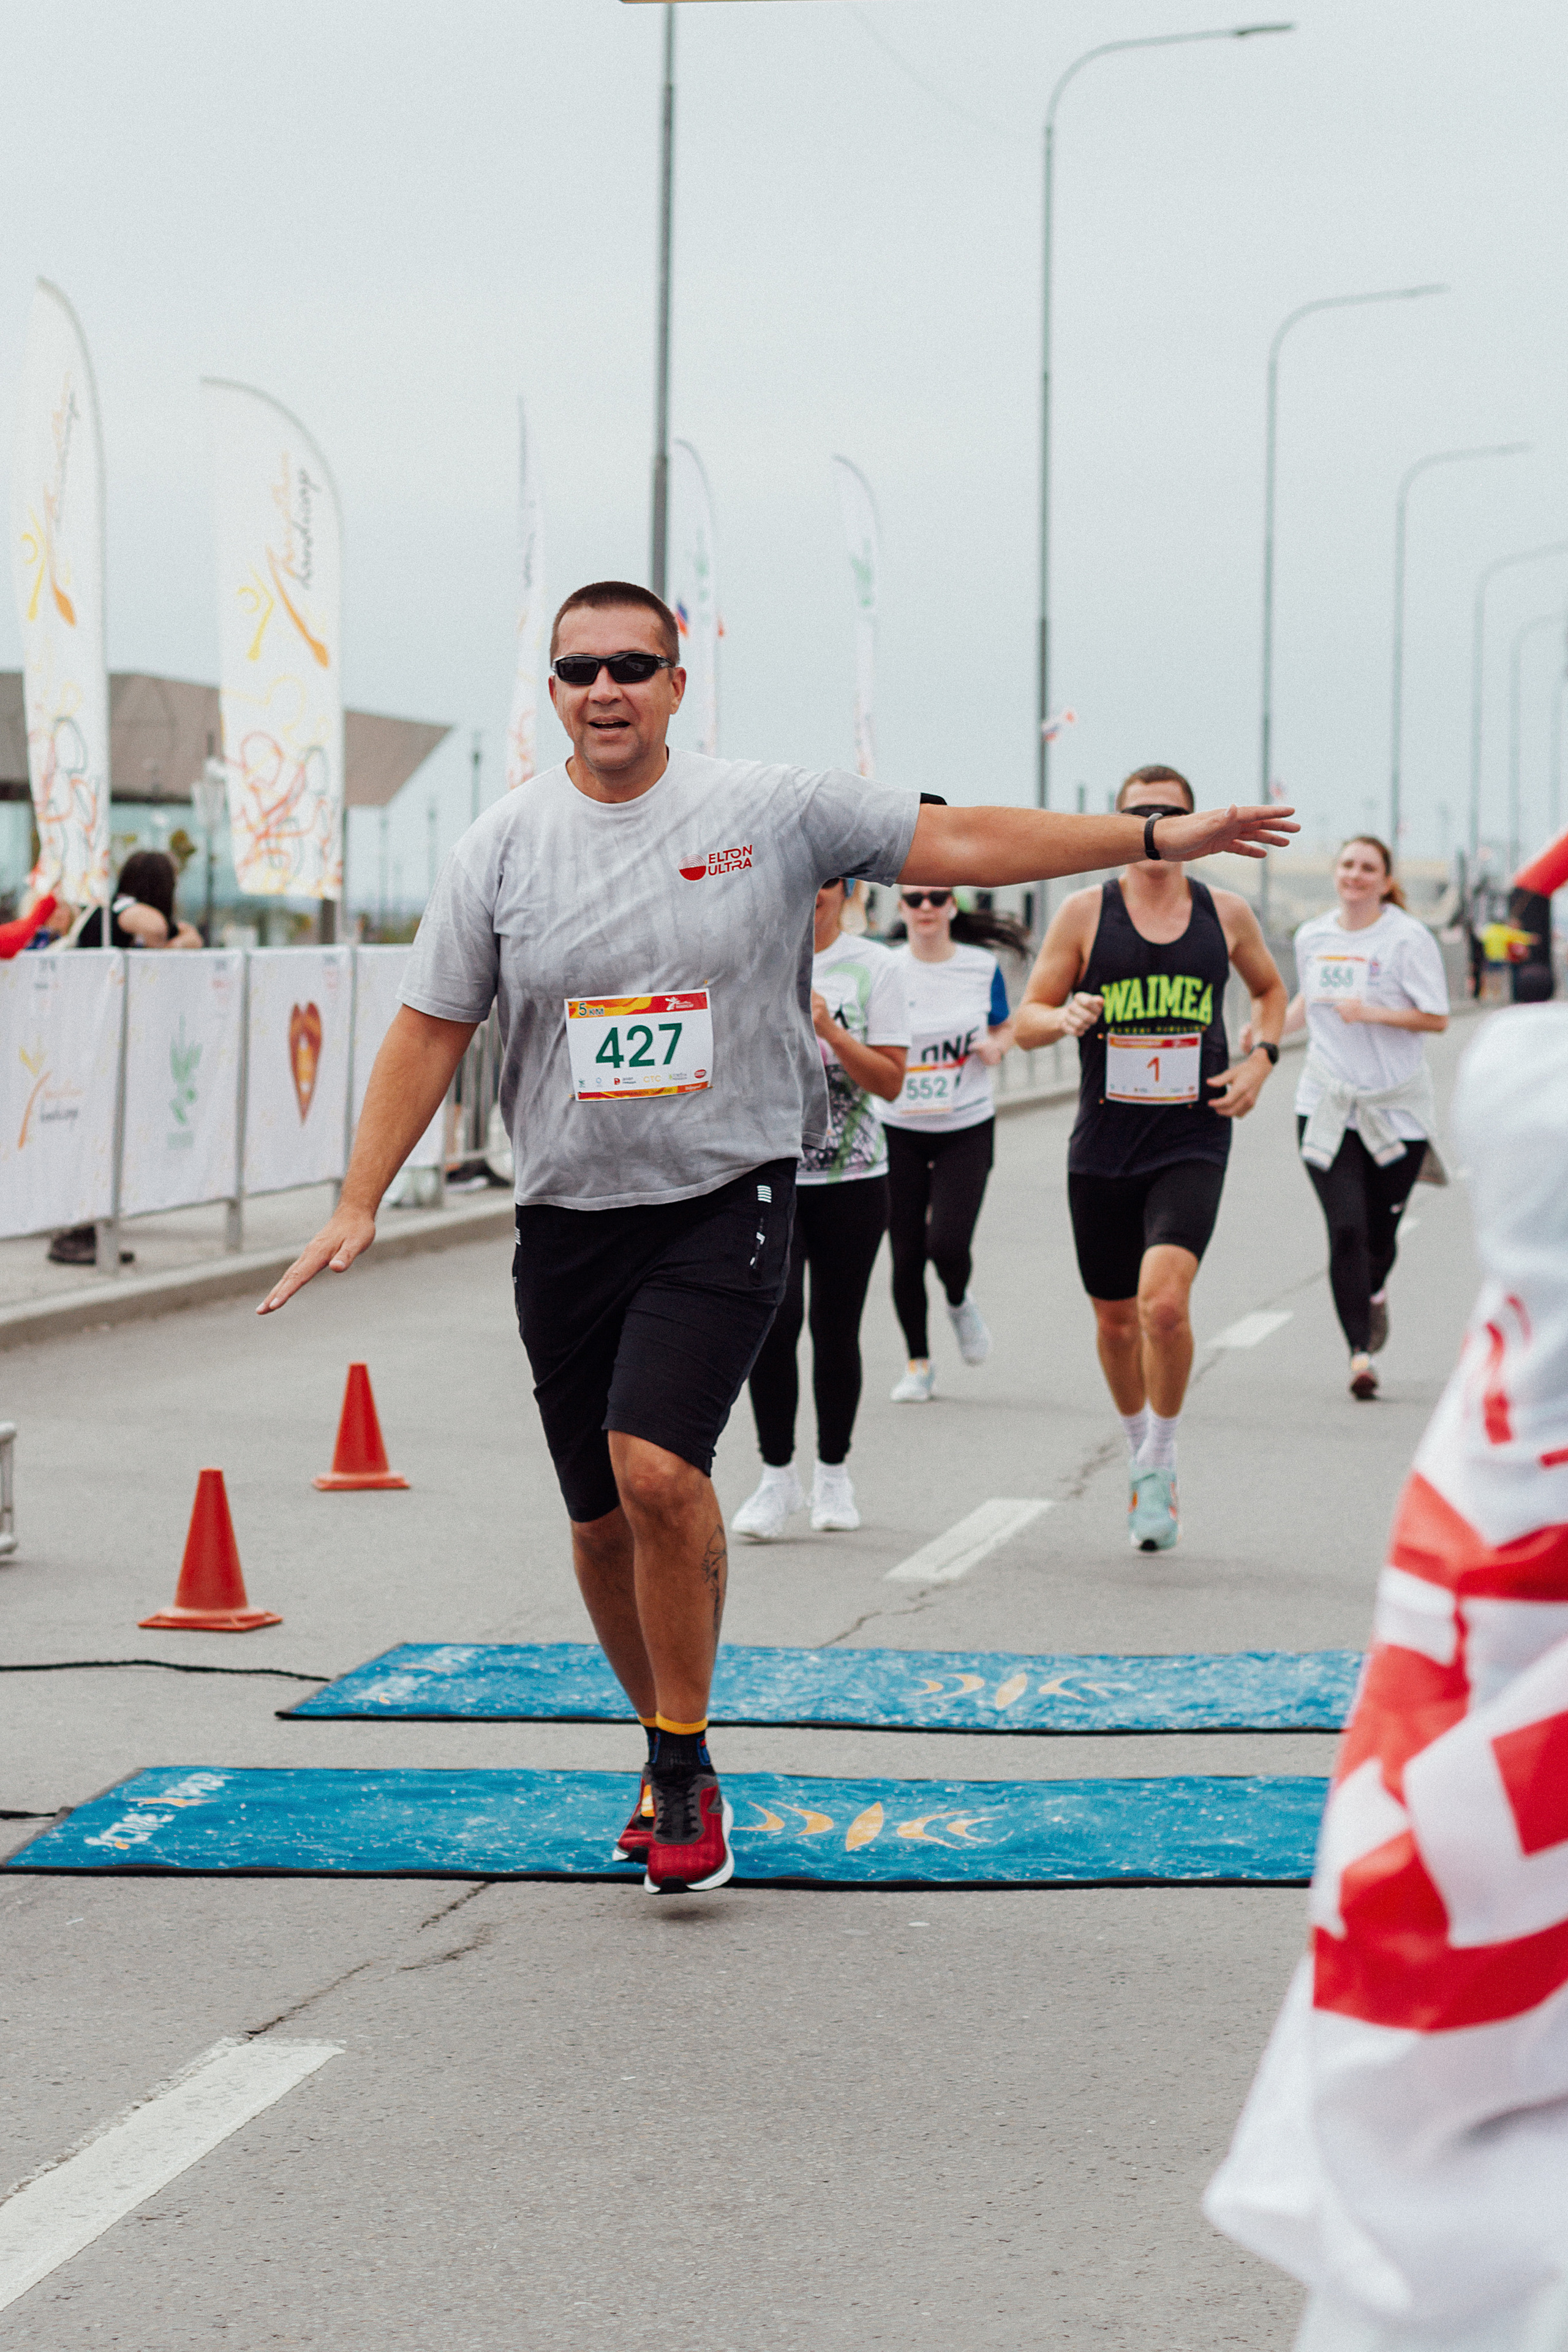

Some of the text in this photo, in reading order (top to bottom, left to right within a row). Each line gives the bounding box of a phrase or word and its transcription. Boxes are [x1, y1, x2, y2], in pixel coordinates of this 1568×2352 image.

[708, 845, 753, 864] ELTON
[708, 858, 753, 876] ULTRA
[578, 1002, 587, 1017] 5
[1100, 974, 1213, 1026] WAIMEA
[595, 1022, 682, 1068] 427
[1147, 1056, 1159, 1083] 1
[906, 1076, 949, 1101] 552
